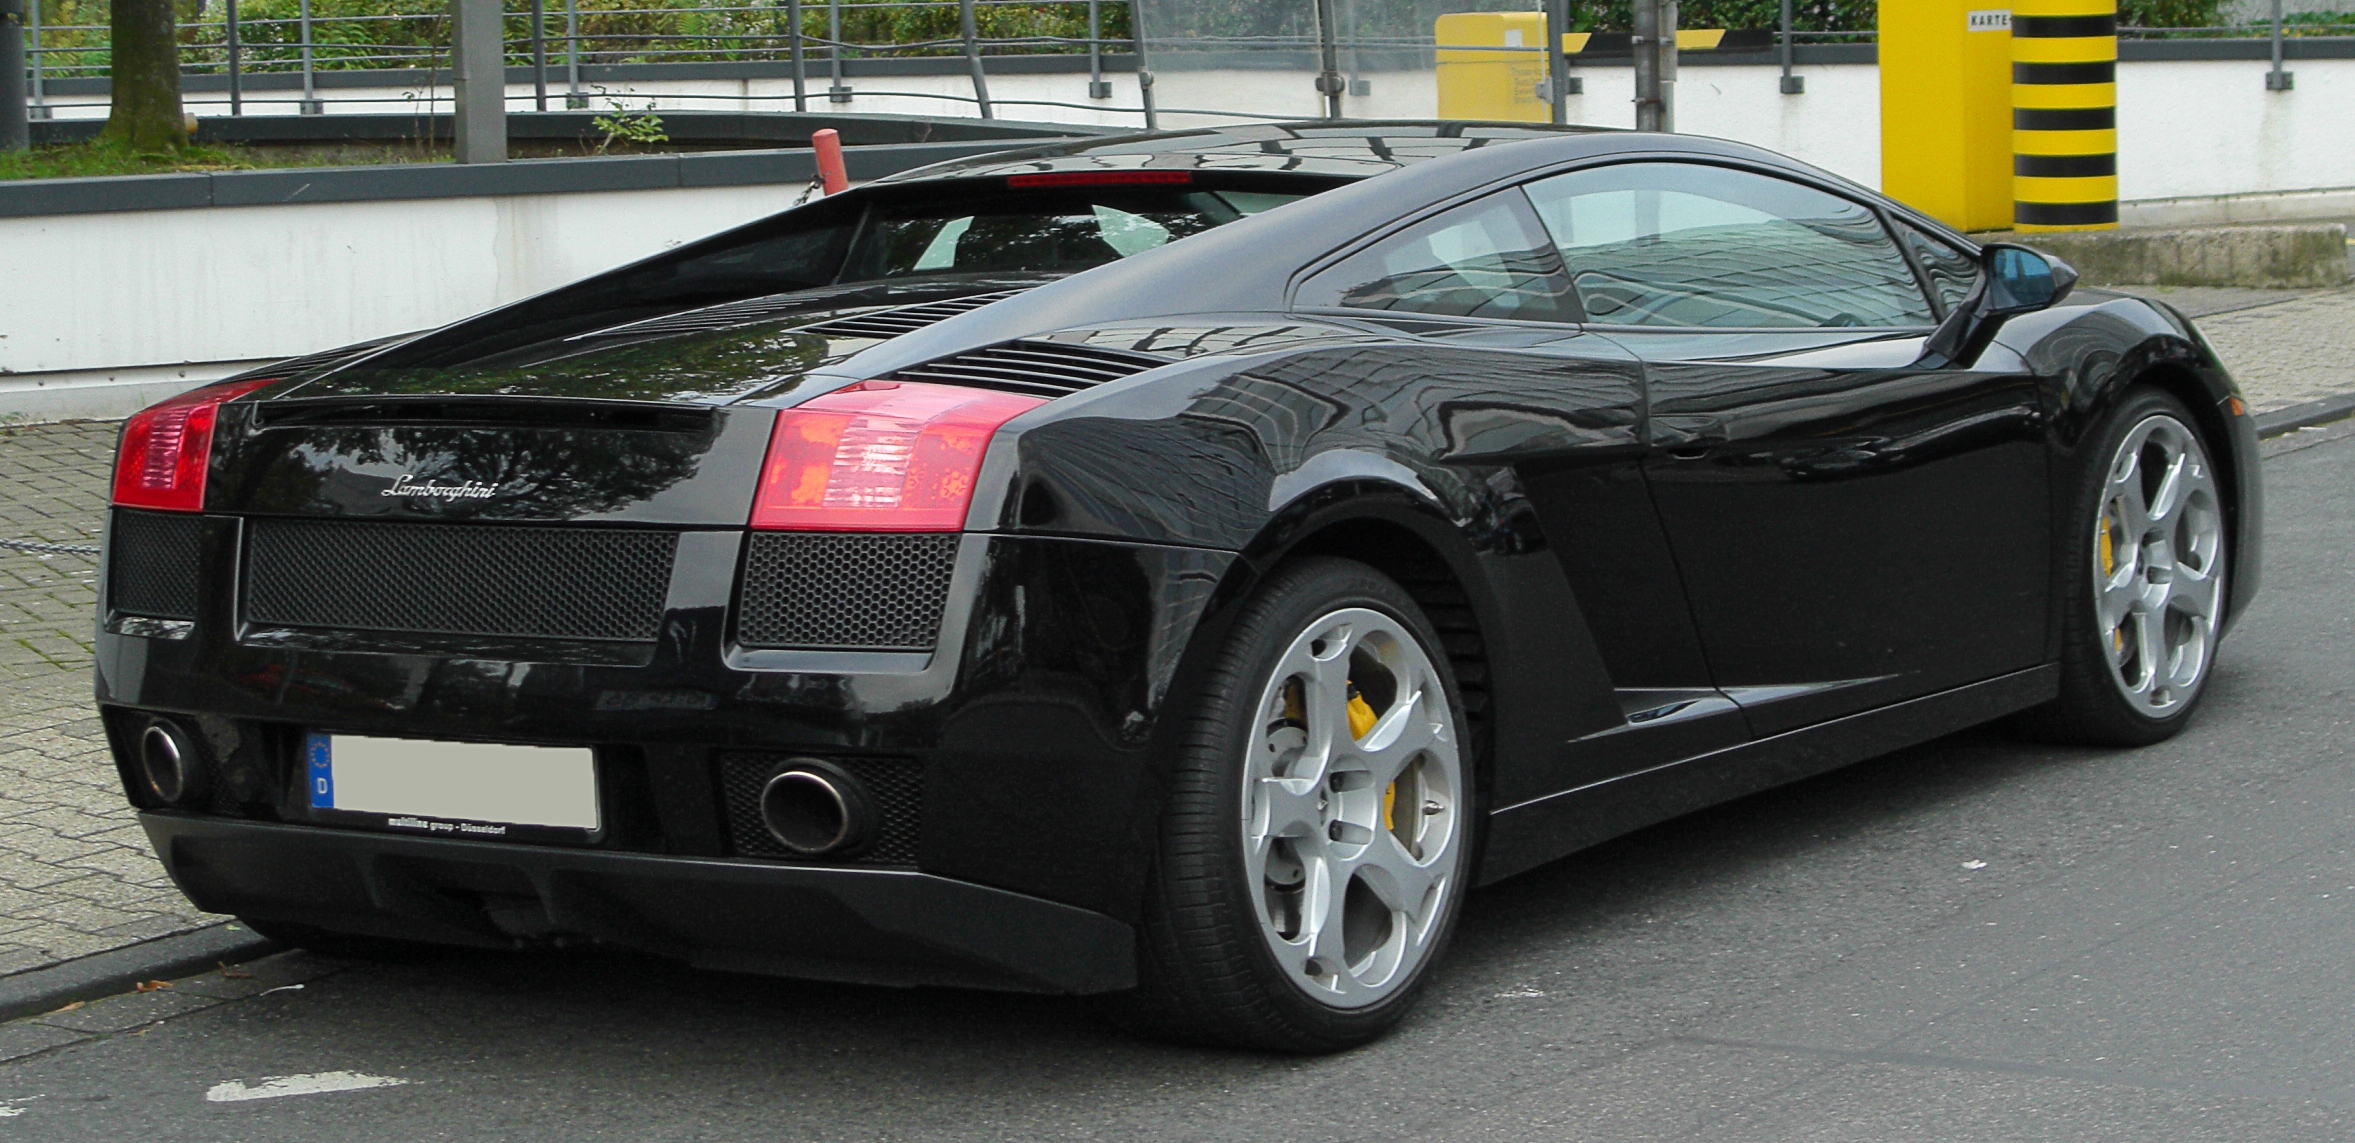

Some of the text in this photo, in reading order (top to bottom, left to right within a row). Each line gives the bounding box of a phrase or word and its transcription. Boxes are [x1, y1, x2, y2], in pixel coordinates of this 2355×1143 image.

[1971, 14, 2007, 26] KARTE
[381, 474, 499, 502] Lamborghini
[317, 777, 328, 794] D
